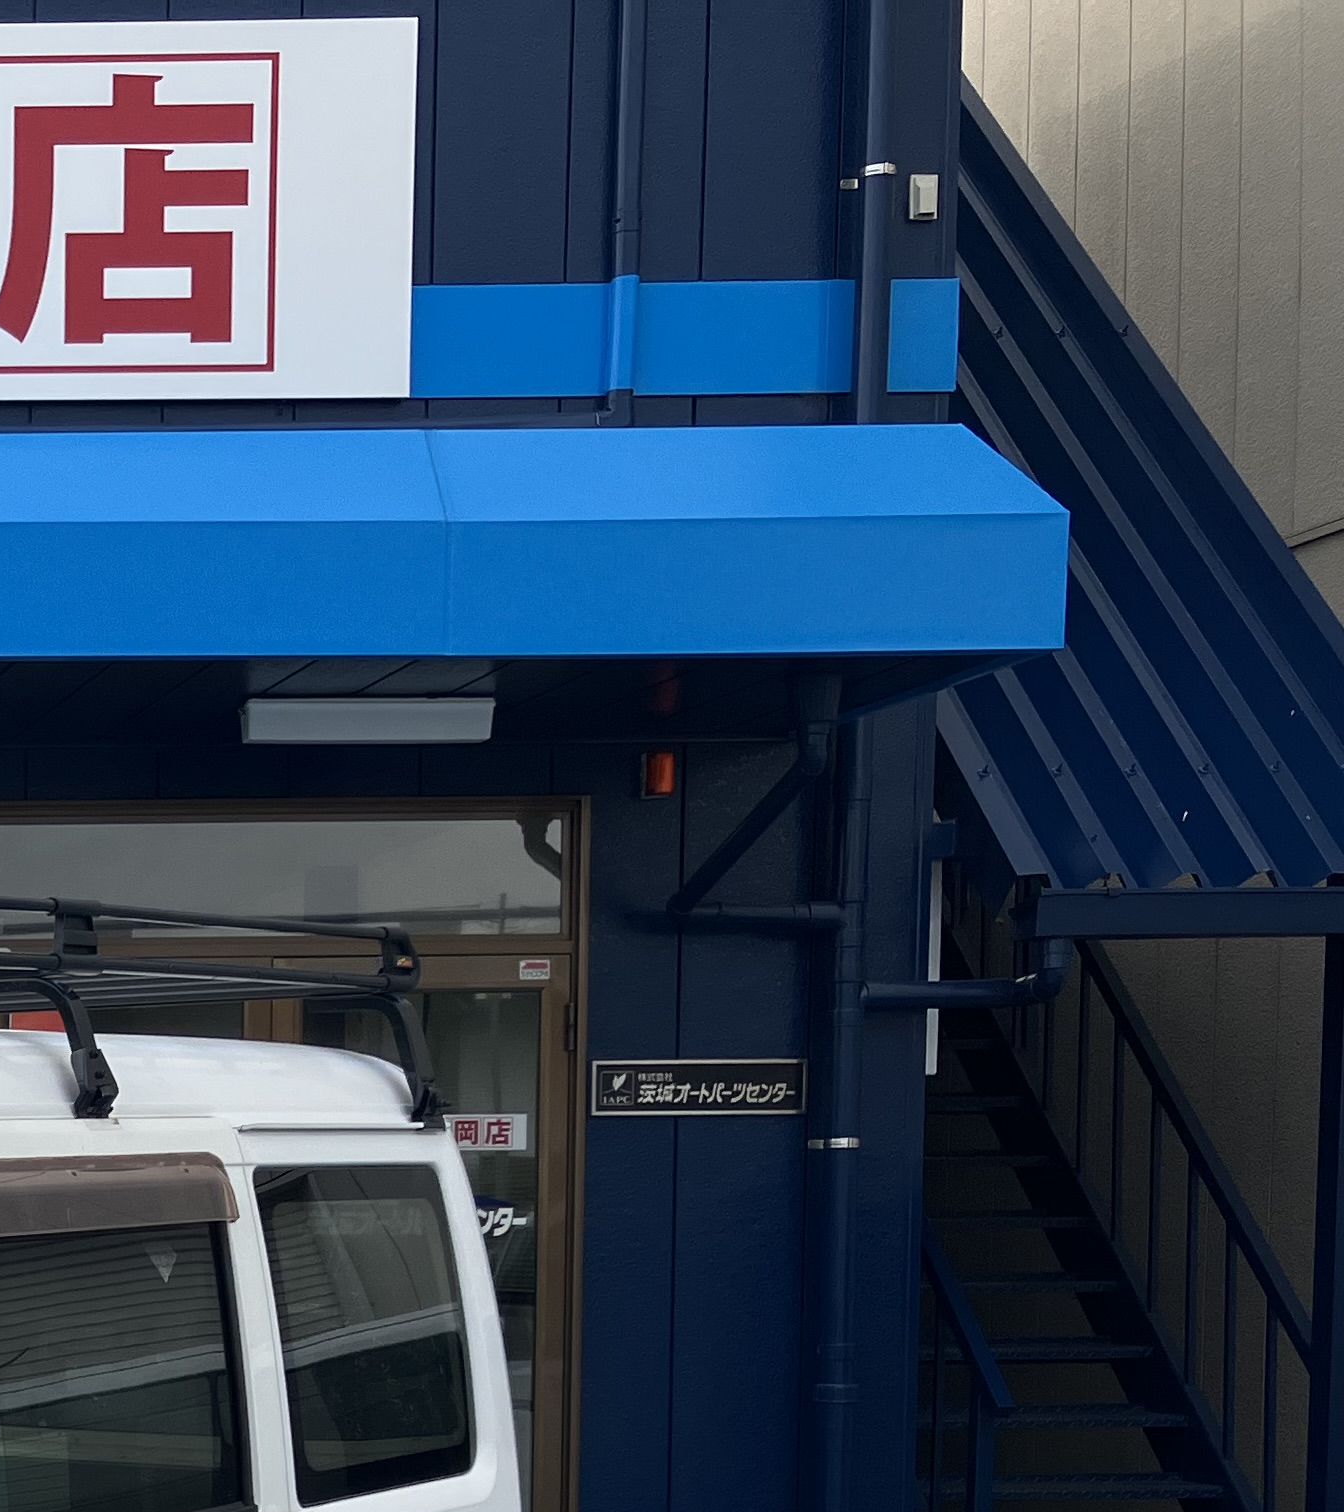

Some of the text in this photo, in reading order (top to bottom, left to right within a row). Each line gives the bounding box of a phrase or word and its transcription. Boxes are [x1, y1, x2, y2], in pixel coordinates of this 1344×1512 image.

[637, 1082, 796, 1104] 茨城オートパーツセンター
[455, 1119, 512, 1147] 岡店
